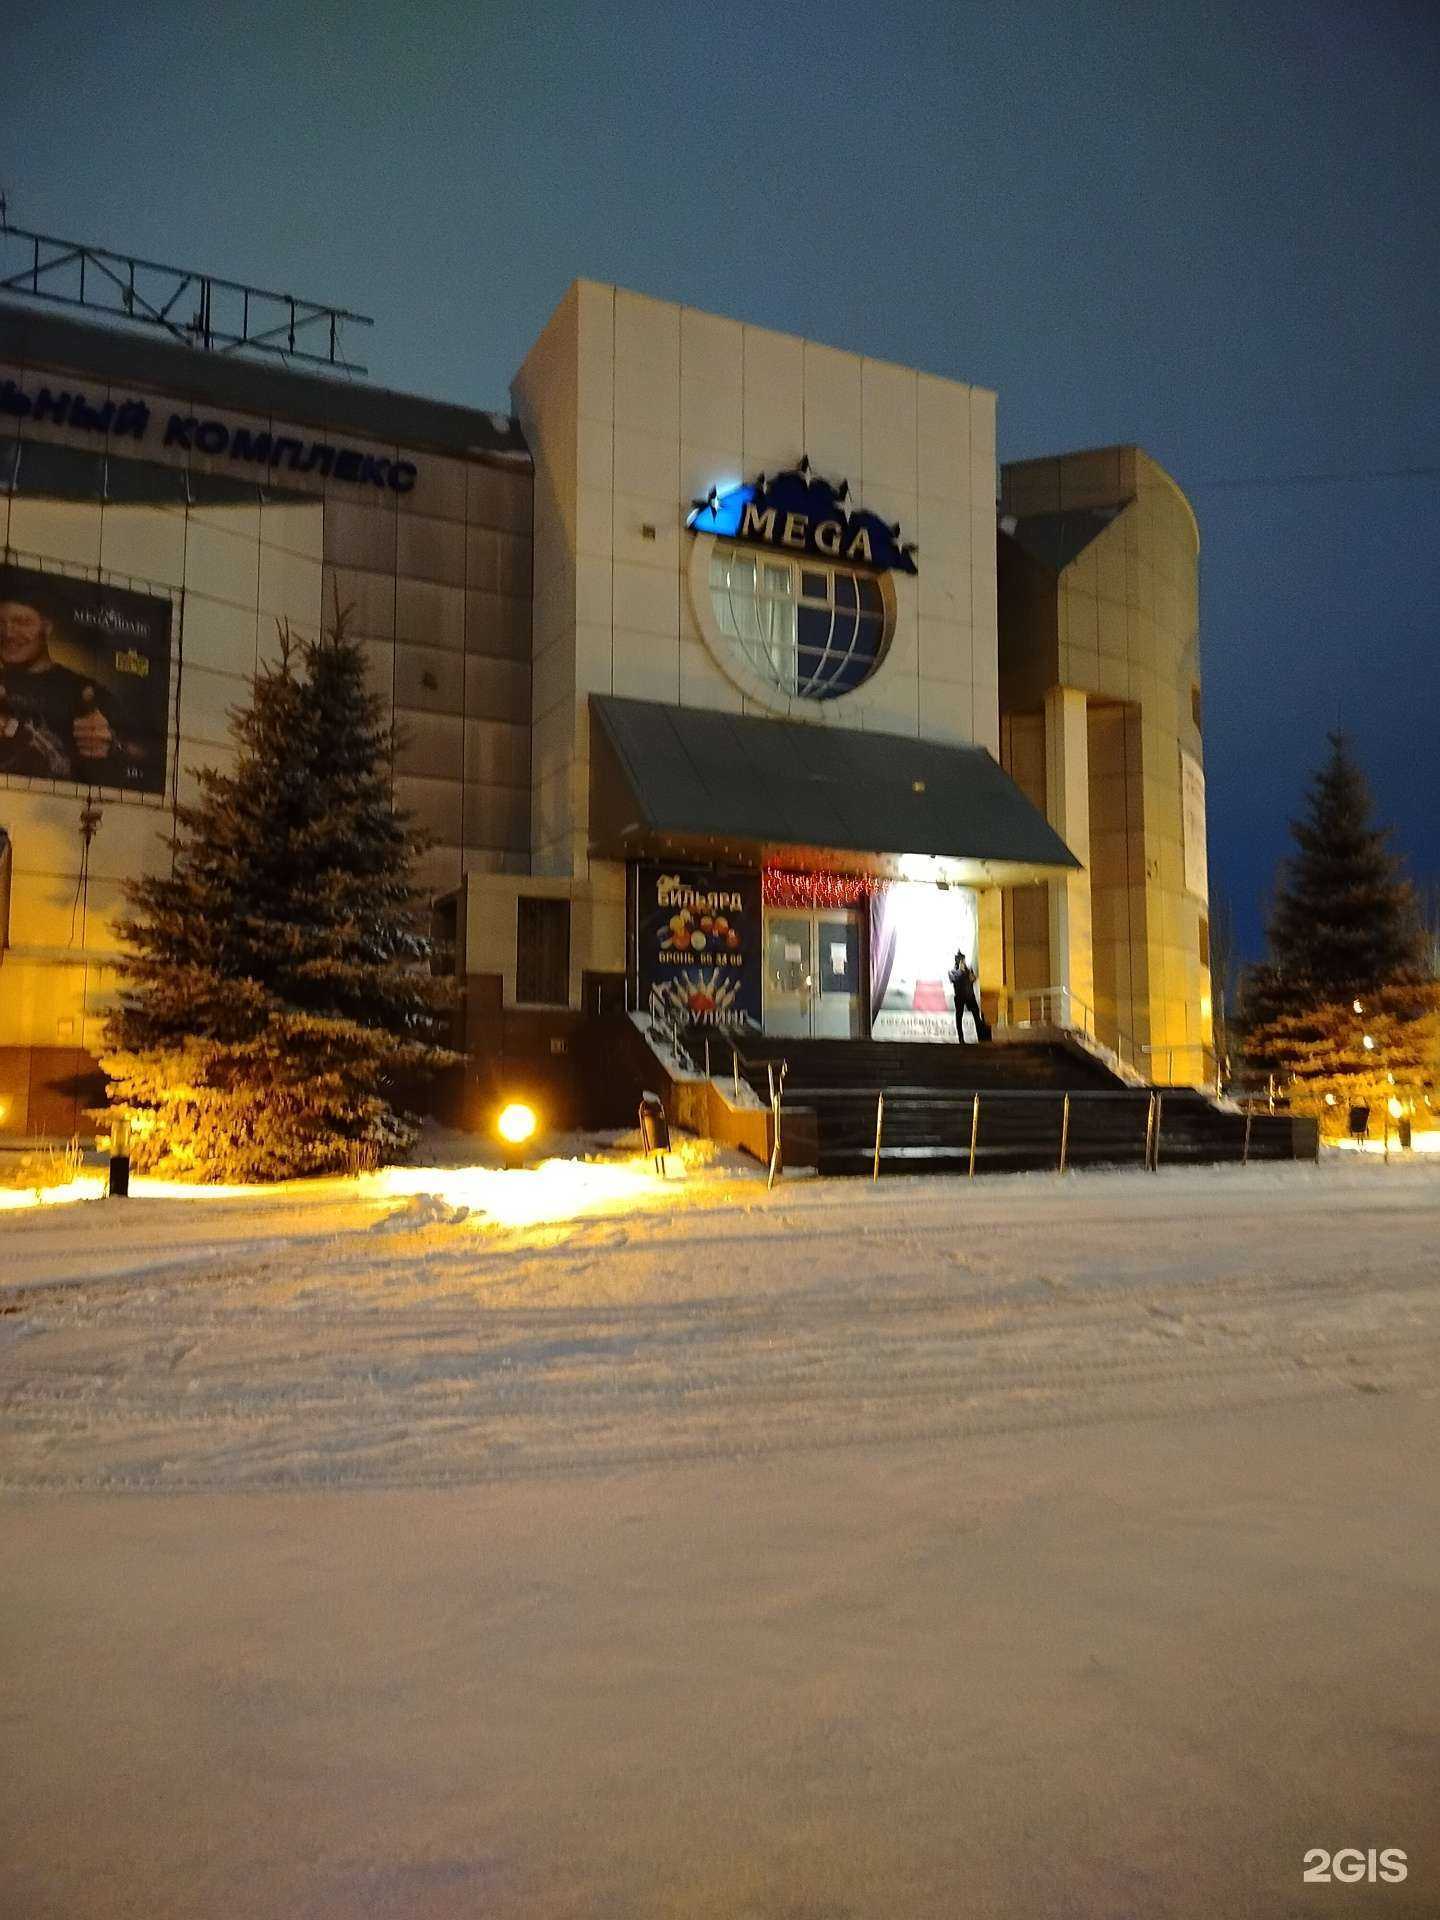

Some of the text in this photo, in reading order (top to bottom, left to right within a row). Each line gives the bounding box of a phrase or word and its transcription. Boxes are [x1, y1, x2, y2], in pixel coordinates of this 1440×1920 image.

[0, 379, 417, 492] ЬНЫЙ КОМПЛЕКС
[742, 503, 873, 562] MEGA
